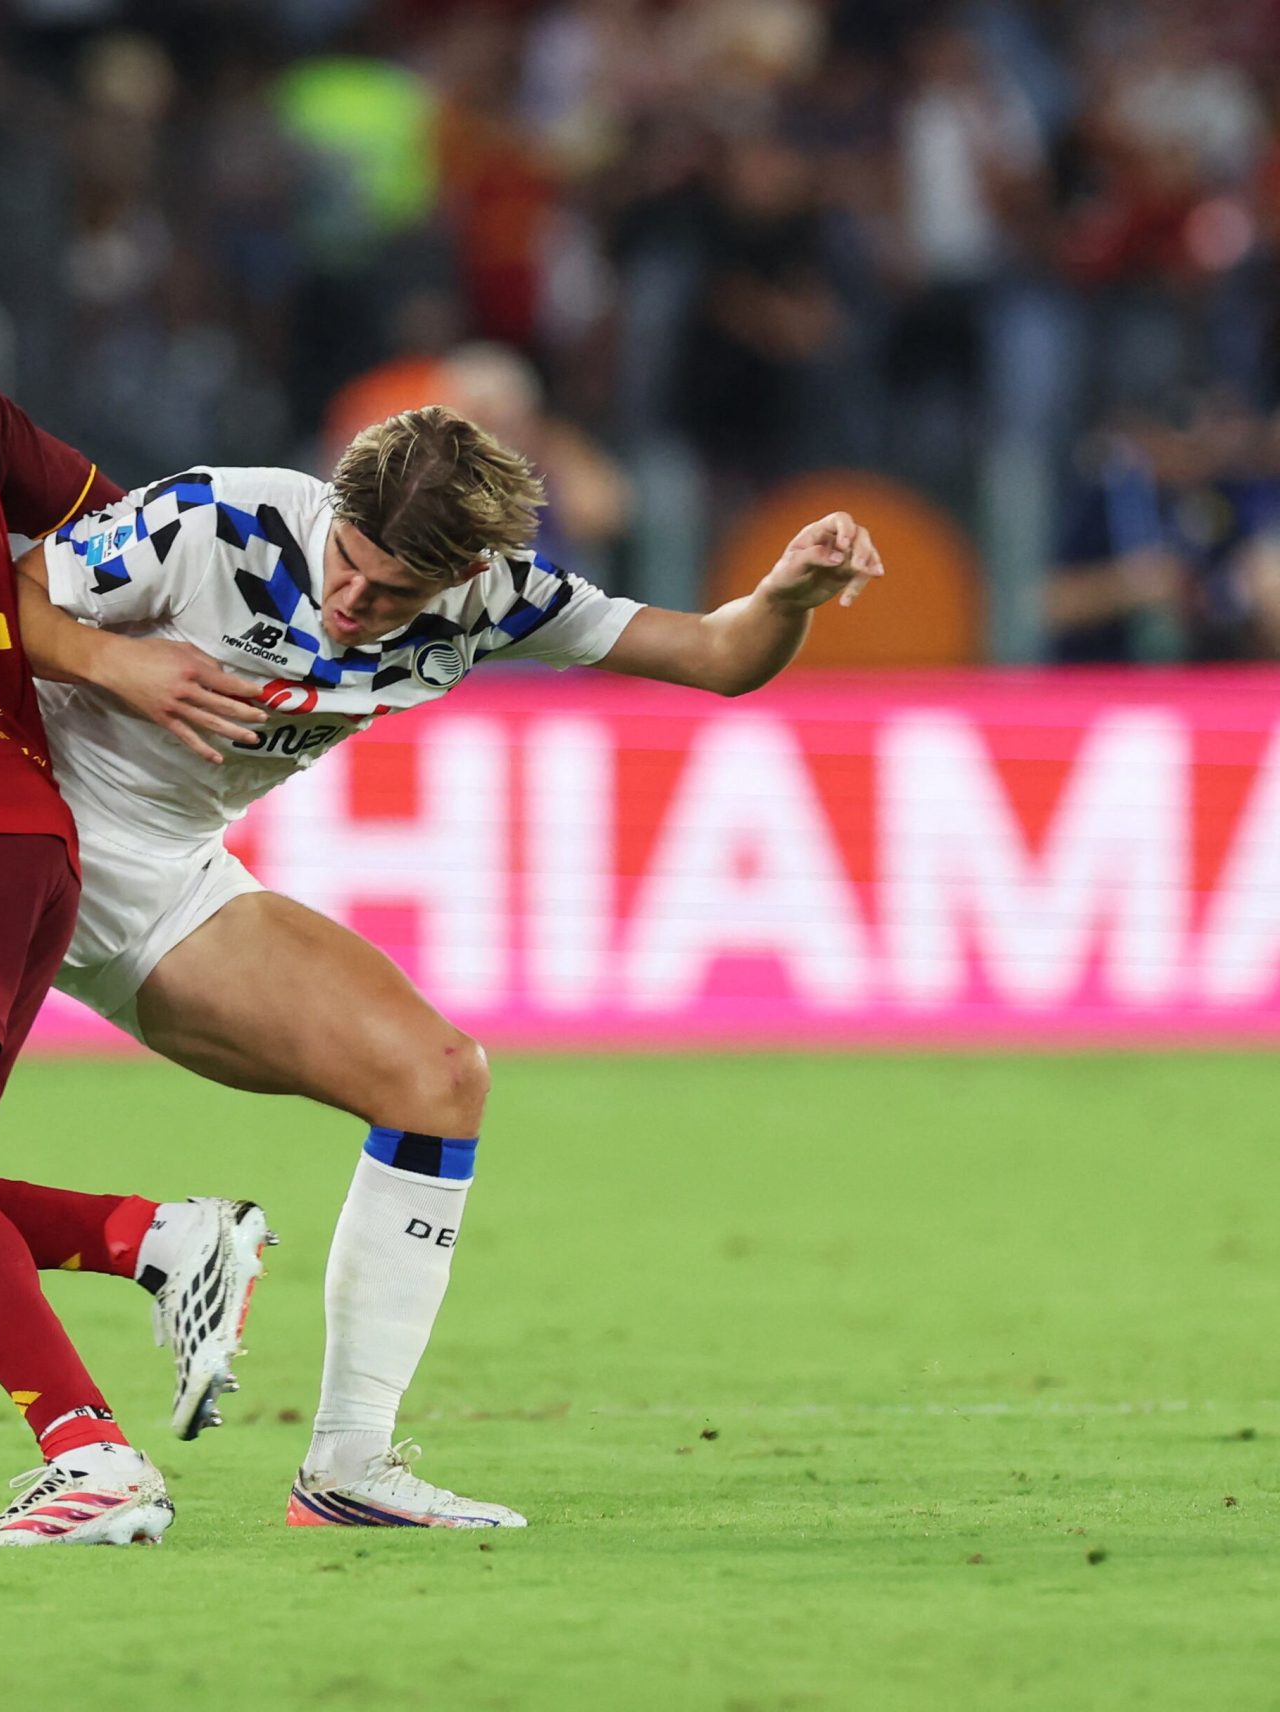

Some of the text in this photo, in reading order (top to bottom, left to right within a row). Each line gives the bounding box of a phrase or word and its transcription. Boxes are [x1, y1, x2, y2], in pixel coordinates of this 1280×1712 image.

[221, 634, 288, 666] new balance
[405, 1218, 457, 1248] DE
